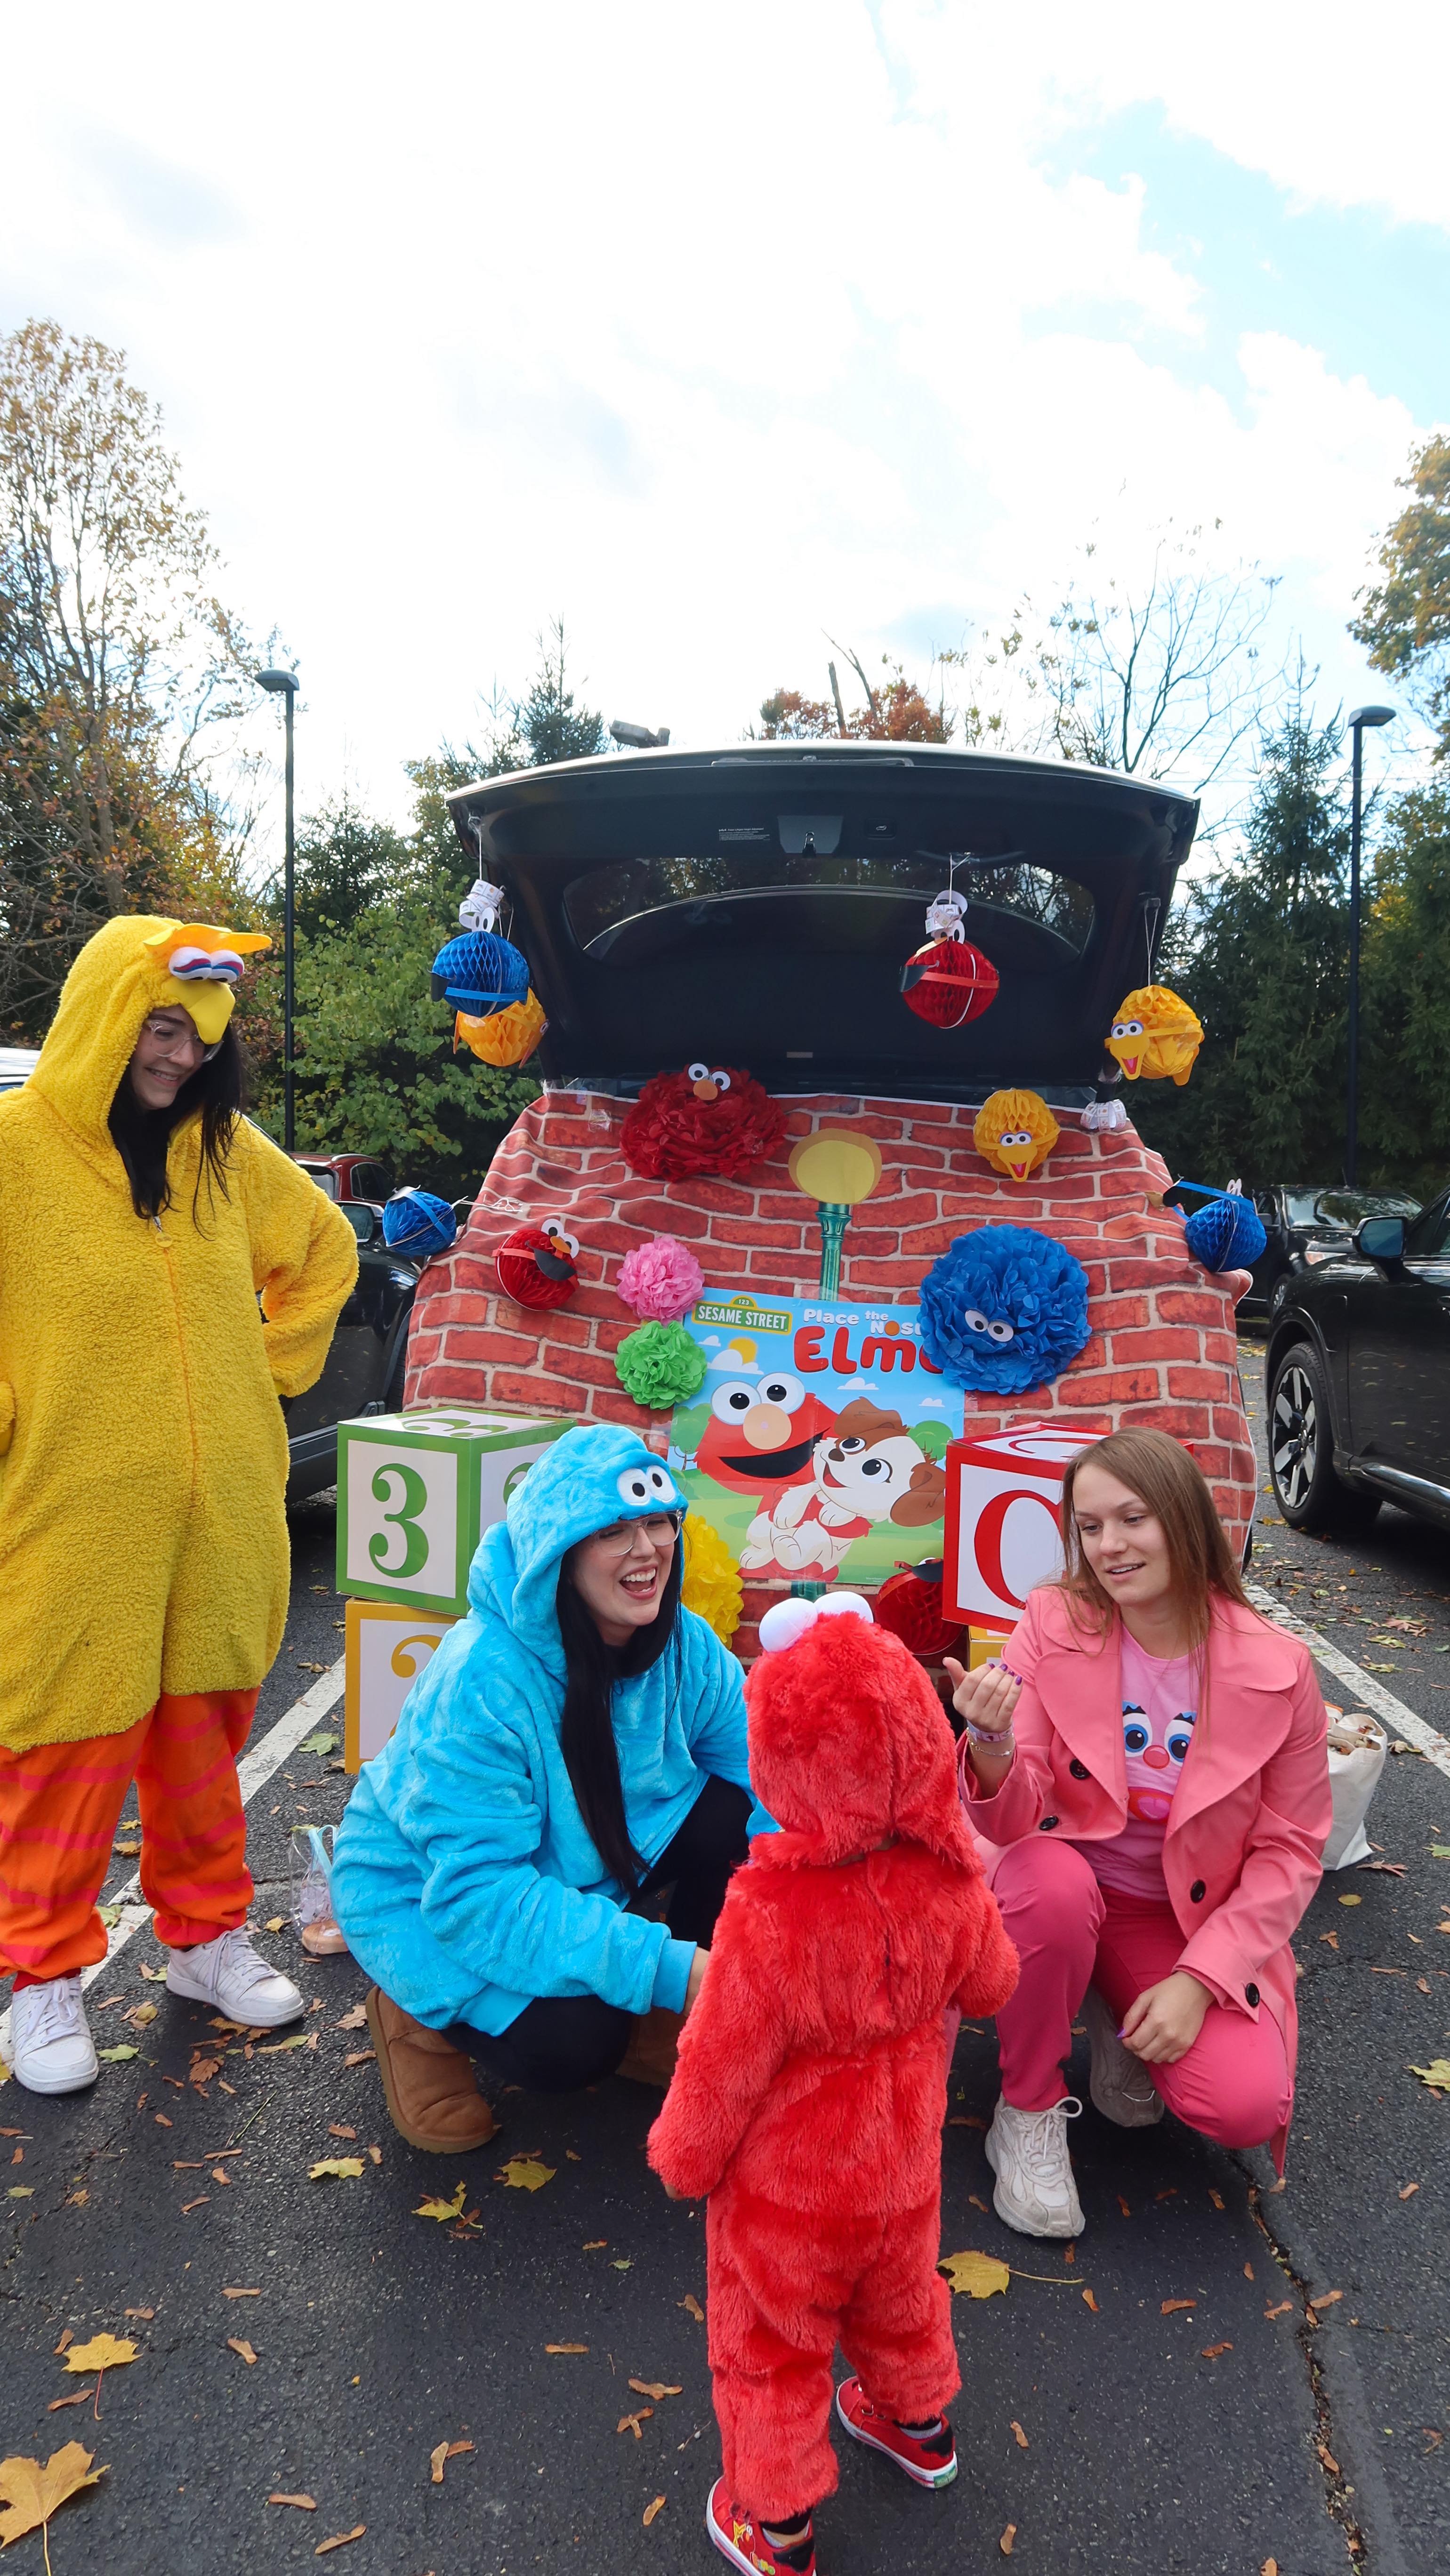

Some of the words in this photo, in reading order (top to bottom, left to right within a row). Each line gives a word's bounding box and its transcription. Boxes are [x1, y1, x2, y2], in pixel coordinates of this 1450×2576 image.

[698, 1305, 742, 1324] SESAME
[745, 1312, 786, 1329] STREET
[804, 1309, 859, 1325] Place
[865, 1310, 889, 1321] the
[369, 1463, 429, 1578] 3
